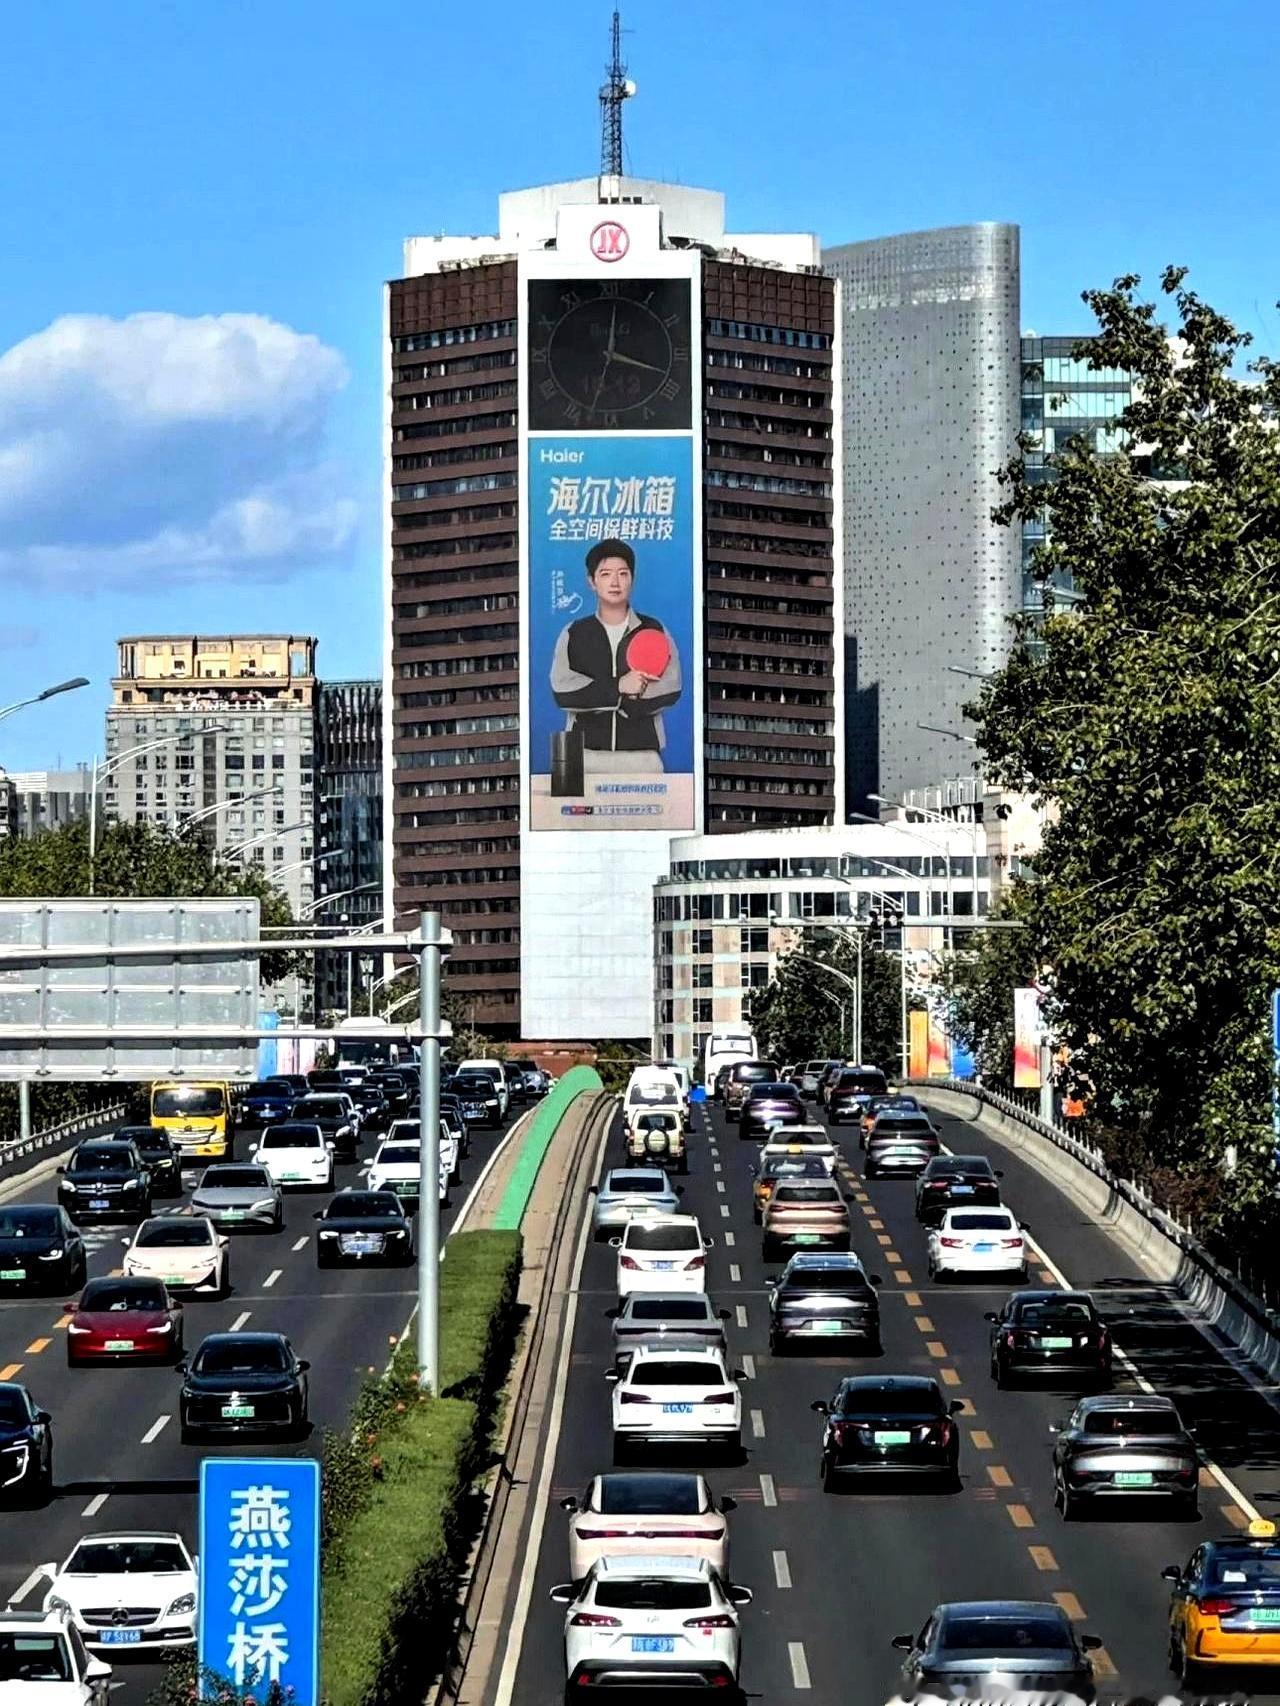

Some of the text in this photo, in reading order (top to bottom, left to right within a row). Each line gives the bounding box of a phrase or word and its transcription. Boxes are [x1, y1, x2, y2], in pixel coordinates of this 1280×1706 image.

[541, 449, 584, 463] Haier
[547, 476, 676, 516] 海尔冰箱
[549, 518, 675, 541] 全空间保鲜科技
[228, 1485, 290, 1685] 燕莎桥
